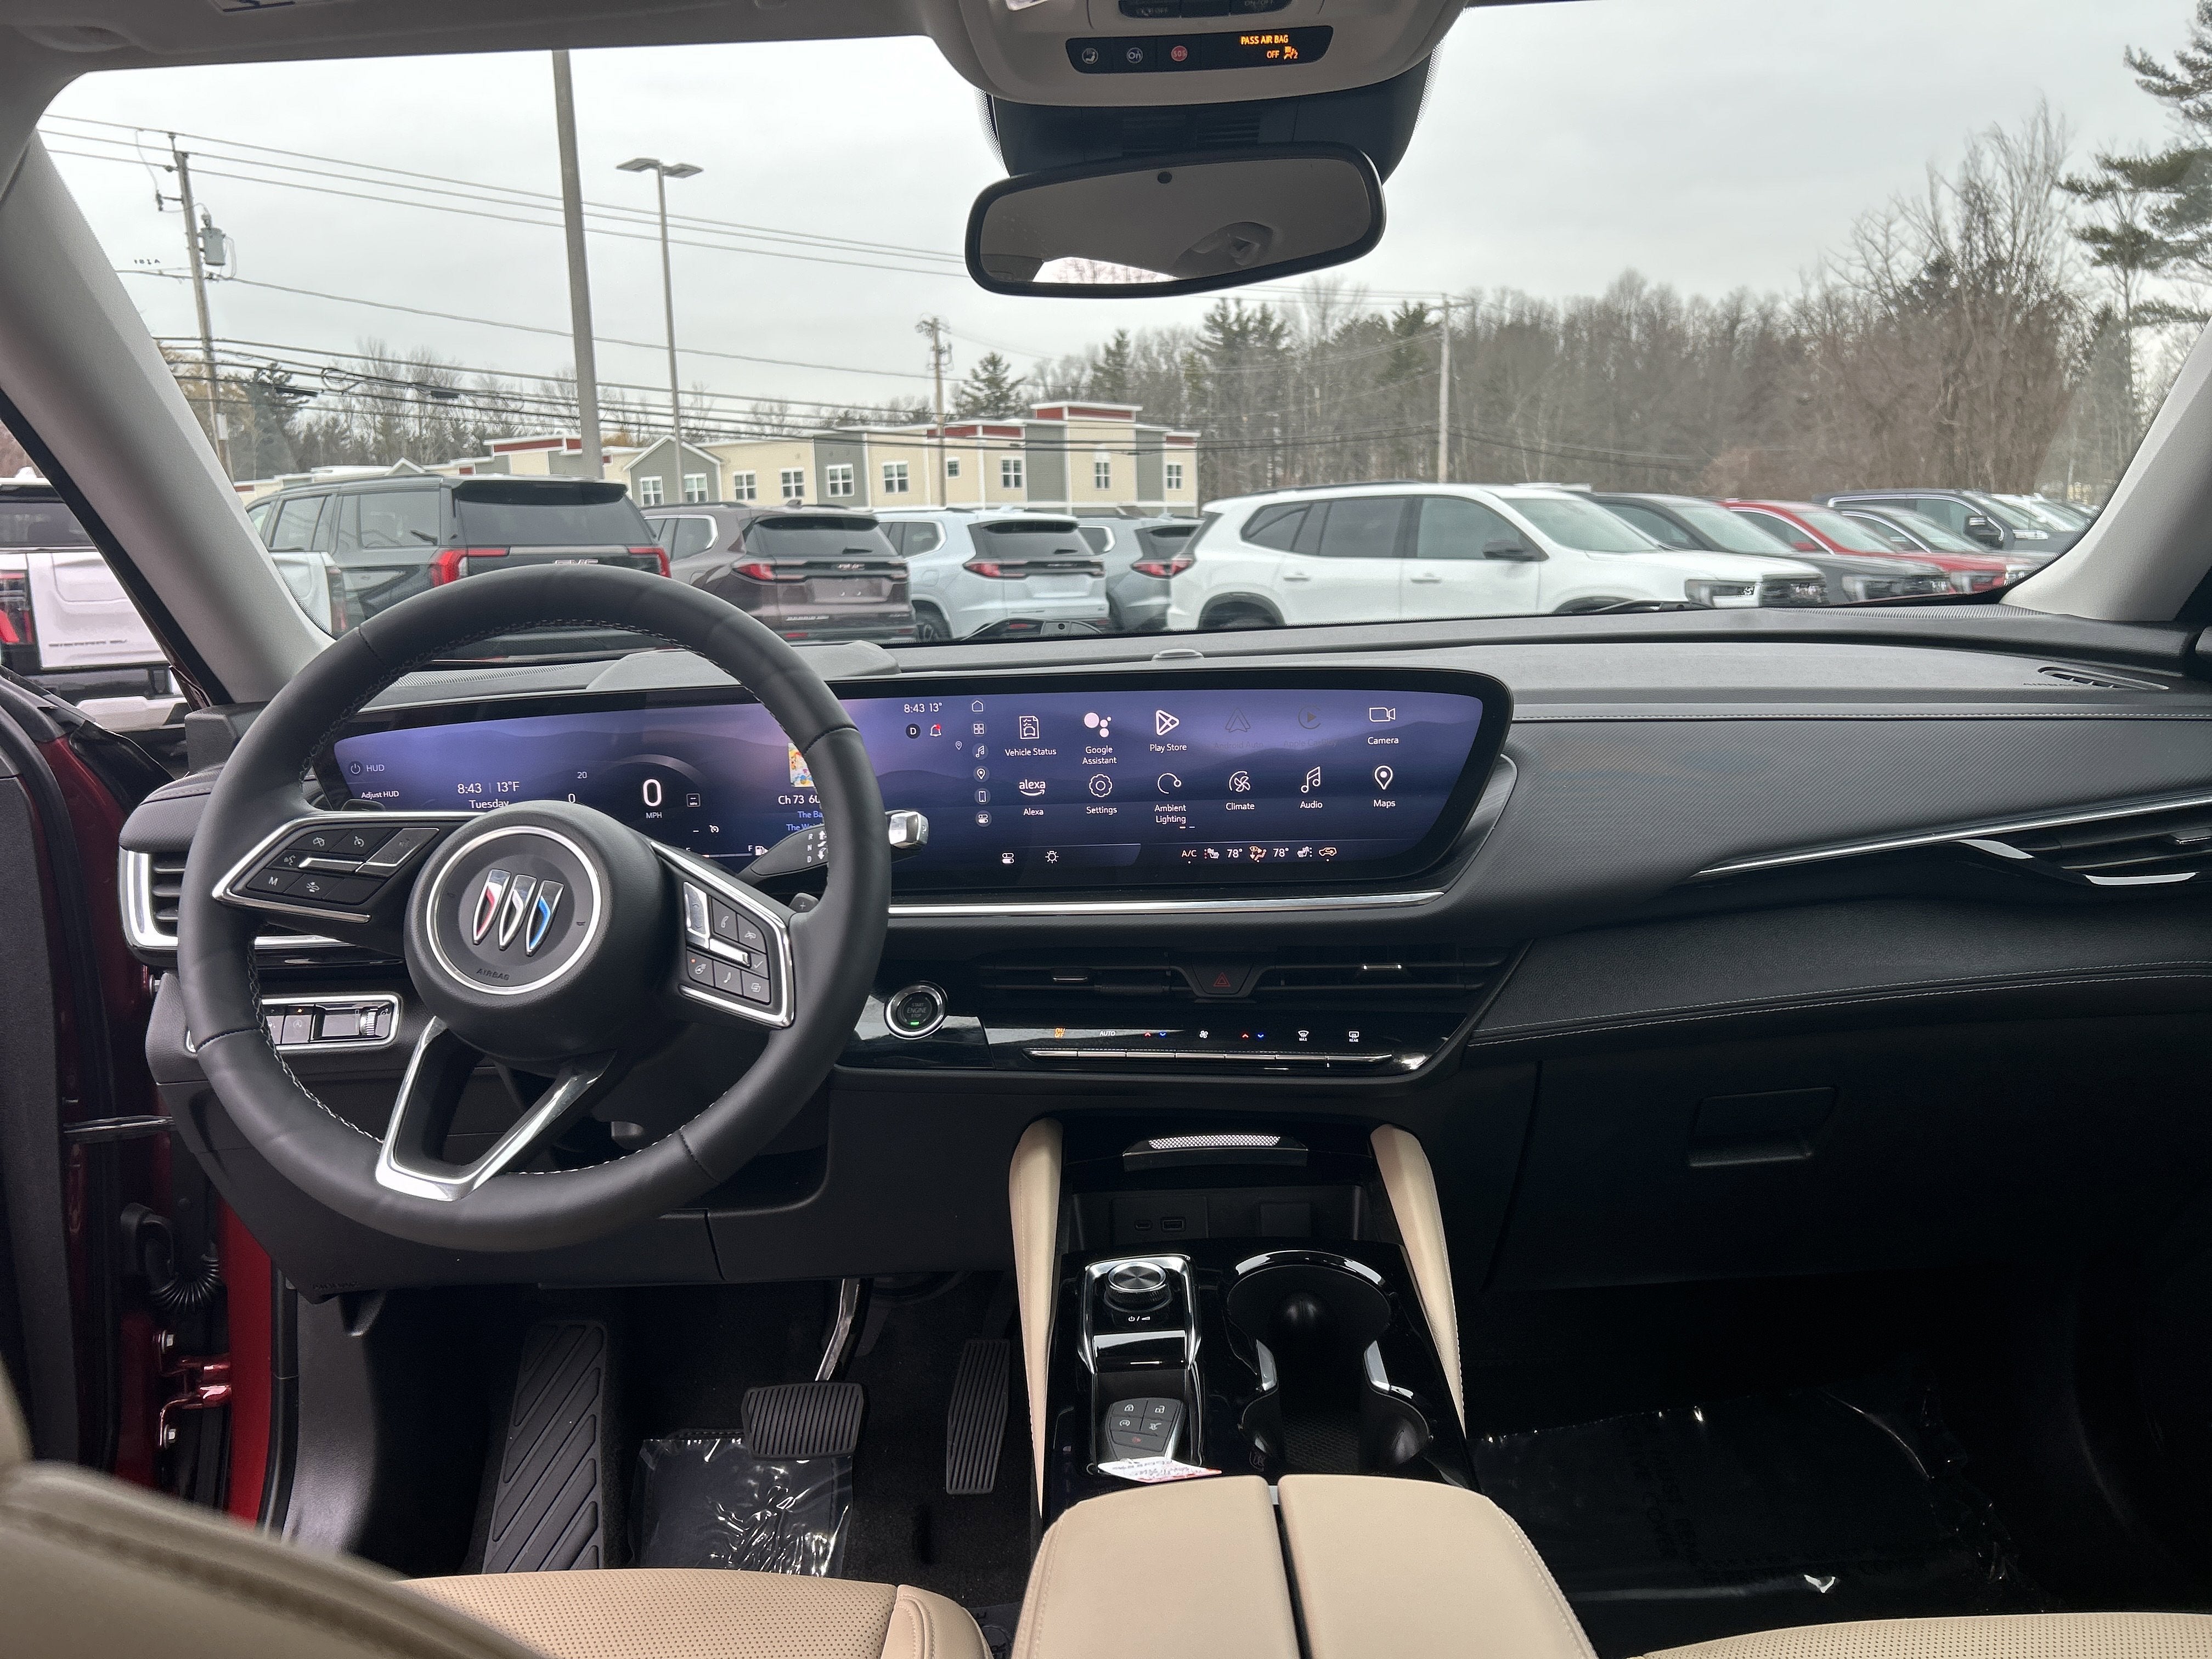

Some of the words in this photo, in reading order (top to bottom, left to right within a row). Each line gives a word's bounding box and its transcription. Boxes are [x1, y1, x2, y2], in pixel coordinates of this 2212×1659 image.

[1241, 36, 1259, 45] PASS
[1261, 35, 1273, 44] AIR
[1274, 35, 1289, 43] BAG
[1267, 50, 1279, 59] OFF
[904, 703, 925, 713] 8:43
[929, 702, 943, 712] 13°
[910, 727, 917, 735] D
[1368, 736, 1399, 745] Camera
[1005, 748, 1031, 757] Vehicle
[1033, 747, 1057, 756] Status
[1085, 746, 1113, 755] Google
[1150, 743, 1166, 753] Play
[1167, 743, 1187, 752] Store
[1082, 756, 1117, 765] Assistant
[366, 764, 385, 772] HUD
[577, 771, 588, 780] 20
[457, 782, 482, 794] 8:43
[496, 781, 520, 793] 13°F
[1019, 780, 1046, 790] alexa
[361, 791, 382, 800] Adjust
[383, 790, 399, 798] HUD
[642, 778, 662, 806] 0
[469, 799, 510, 809] Tuesday
[778, 795, 791, 805] Ch
[793, 795, 805, 804] 73
[1300, 800, 1323, 809] Audio
[1373, 799, 1396, 809] Maps
[1086, 805, 1118, 815] Settings
[1154, 804, 1187, 812] Ambient
[1226, 802, 1255, 811] Climate
[1023, 808, 1044, 816] Alexa
[1155, 815, 1187, 825] Lighting
[1182, 849, 1197, 858] A/C
[1227, 848, 1243, 858] 78°
[1273, 848, 1289, 857] 78°
[268, 877, 278, 886] M
[476, 968, 510, 981] AIRBAG
